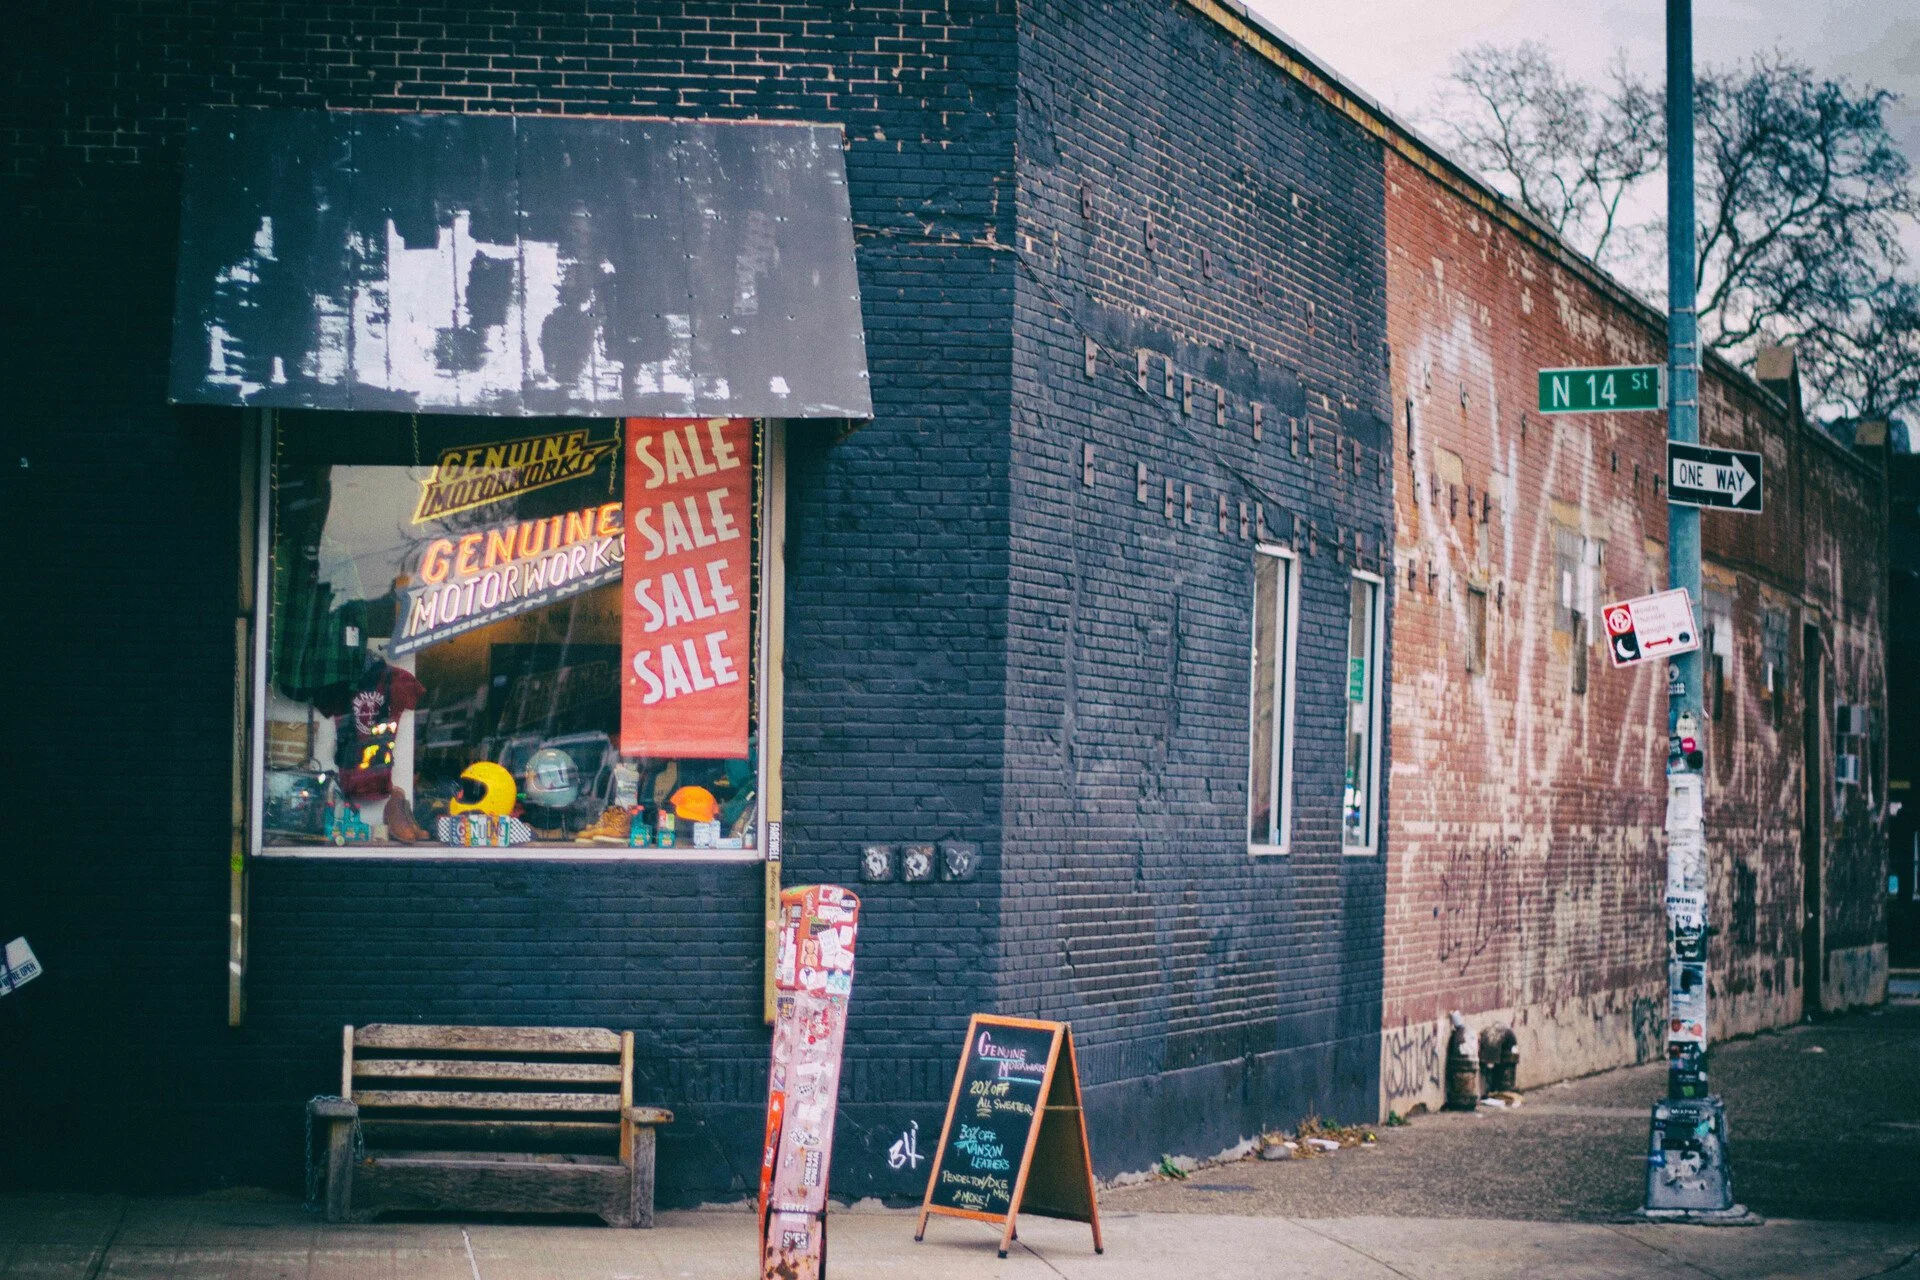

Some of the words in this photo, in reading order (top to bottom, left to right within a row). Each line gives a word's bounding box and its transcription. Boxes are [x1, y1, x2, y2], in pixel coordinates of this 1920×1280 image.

[1552, 375, 1570, 407] N
[1586, 373, 1617, 406] 14
[1631, 372, 1649, 390] St
[437, 432, 582, 481] GENUINE
[635, 417, 741, 489] SALE
[1679, 463, 1704, 487] ONE
[1716, 468, 1746, 492] WAY
[421, 501, 624, 585] GENUINE
[634, 487, 740, 561] SALE
[634, 559, 740, 633] SALE
[633, 630, 739, 705] SALE
[978, 1031, 1027, 1058] GENUINE
